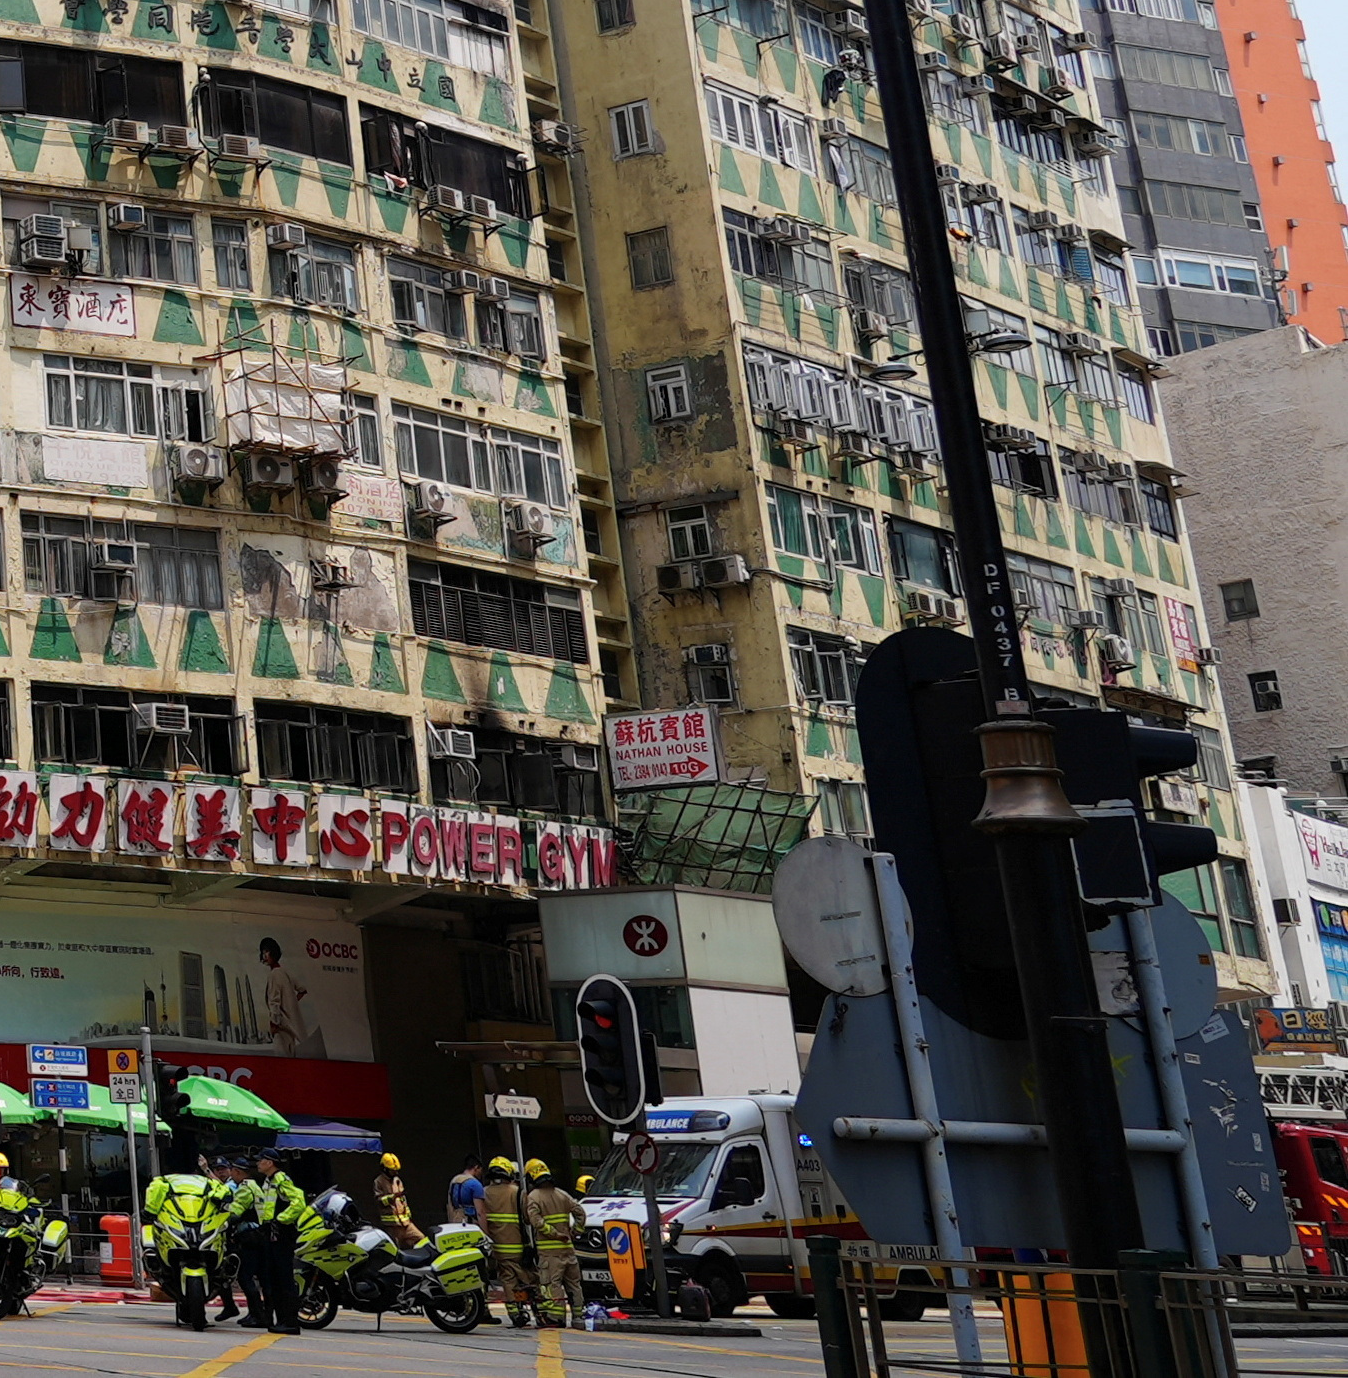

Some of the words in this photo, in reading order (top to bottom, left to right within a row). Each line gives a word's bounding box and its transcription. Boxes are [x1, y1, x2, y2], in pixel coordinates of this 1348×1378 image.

[614, 712, 705, 747] 蘇杭賓館
[615, 746, 662, 761] NATHAN
[667, 741, 709, 755] HOUSE
[673, 760, 699, 775] 10G
[382, 811, 522, 878] POWER
[538, 830, 617, 887] GYM
[321, 942, 358, 960] OCBC
[112, 1076, 122, 1085] 24
[647, 1117, 690, 1129] BULANCE
[796, 1159, 820, 1171] A403
